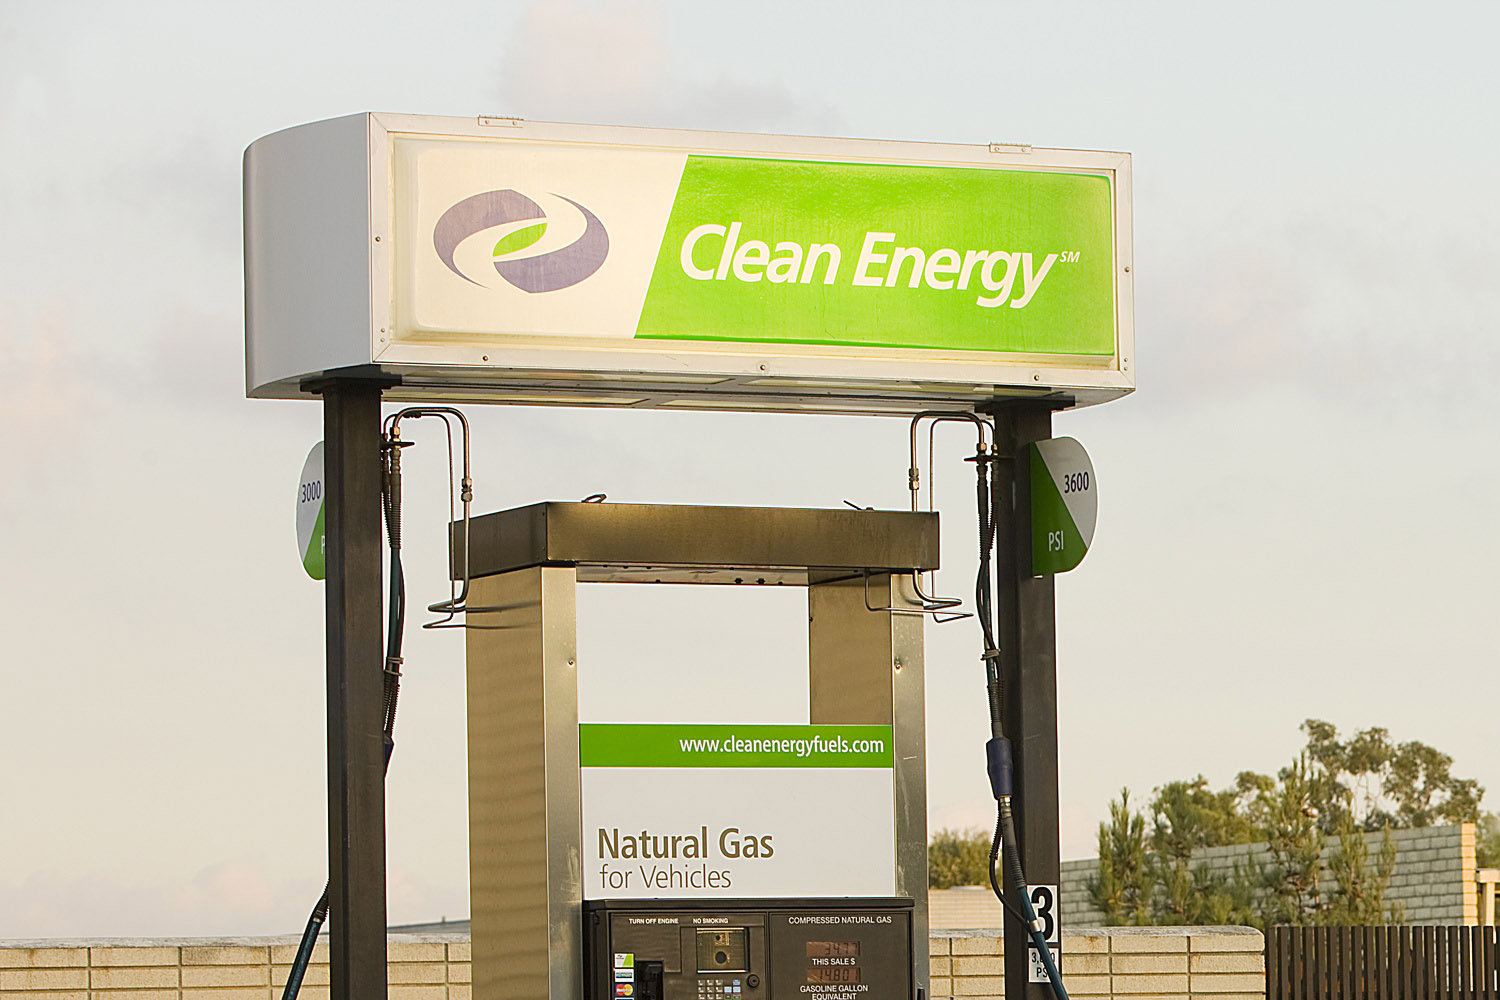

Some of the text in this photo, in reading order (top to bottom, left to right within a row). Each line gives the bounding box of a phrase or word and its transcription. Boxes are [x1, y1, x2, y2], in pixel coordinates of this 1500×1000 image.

[679, 220, 1081, 309] Clean Energy SM
[301, 479, 322, 503] 3000
[1063, 471, 1090, 494] 3600
[1048, 530, 1065, 552] PSI
[679, 735, 885, 758] www.cleanenergyfuels.com
[597, 826, 775, 859] Natural Gas
[599, 863, 732, 889] for Vehicles
[788, 916, 892, 925] COMPRESSED NATURAL GAS
[1030, 886, 1054, 942] 3
[811, 958, 829, 966] THIS
[830, 958, 850, 966] SALE
[1031, 951, 1056, 965] 3,0
[1036, 967, 1049, 978] PS
[799, 984, 869, 993] GASOLINE GALLON
[811, 992, 857, 1000] EQUIVALENT
